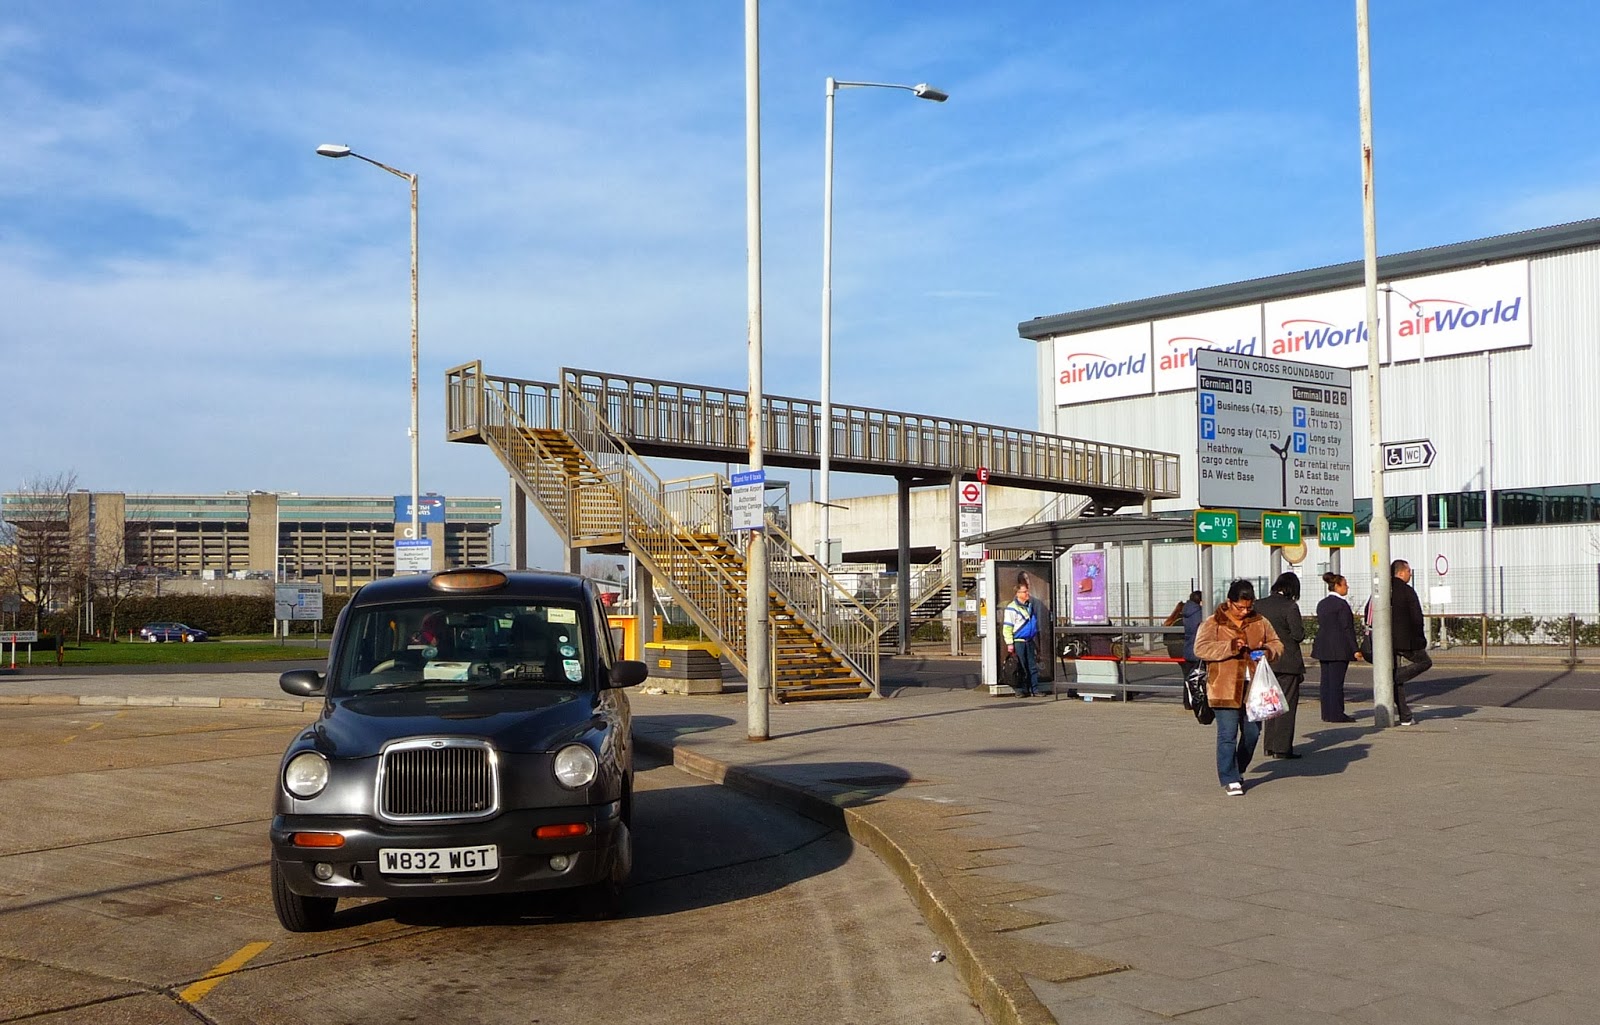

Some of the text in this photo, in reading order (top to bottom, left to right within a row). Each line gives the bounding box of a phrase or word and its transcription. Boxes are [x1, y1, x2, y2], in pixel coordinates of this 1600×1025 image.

[1398, 297, 1522, 337] airWorld
[1060, 354, 1146, 384] airWorld
[1217, 356, 1334, 380] HATTON CROSS ROUNDABOUT
[1201, 378, 1251, 392] Terminal 4 5
[1294, 388, 1321, 400] Terminal
[1333, 393, 1338, 403] 2
[1341, 394, 1346, 404] 3
[1218, 400, 1249, 412] Business
[1310, 407, 1339, 418] Business
[1308, 418, 1342, 431] (T1 to T3)
[1218, 425, 1235, 436] Long
[1238, 427, 1253, 438] stay
[1310, 432, 1341, 445] Long stay
[1207, 442, 1243, 454] Heathrow
[1308, 445, 1339, 457] (T1 to T3)
[1202, 456, 1248, 466] cargo centre
[1406, 450, 1419, 460] WC
[1294, 458, 1350, 471] Car rental return
[981, 470, 986, 480] E
[1202, 469, 1254, 481] BA West Base
[1294, 470, 1339, 481] BA East Base
[1300, 485, 1334, 496] X2 Hatton
[1294, 496, 1339, 507] Cross Centre
[1222, 529, 1228, 538] S
[1272, 530, 1277, 539] E
[386, 849, 489, 869] W832 WGT
